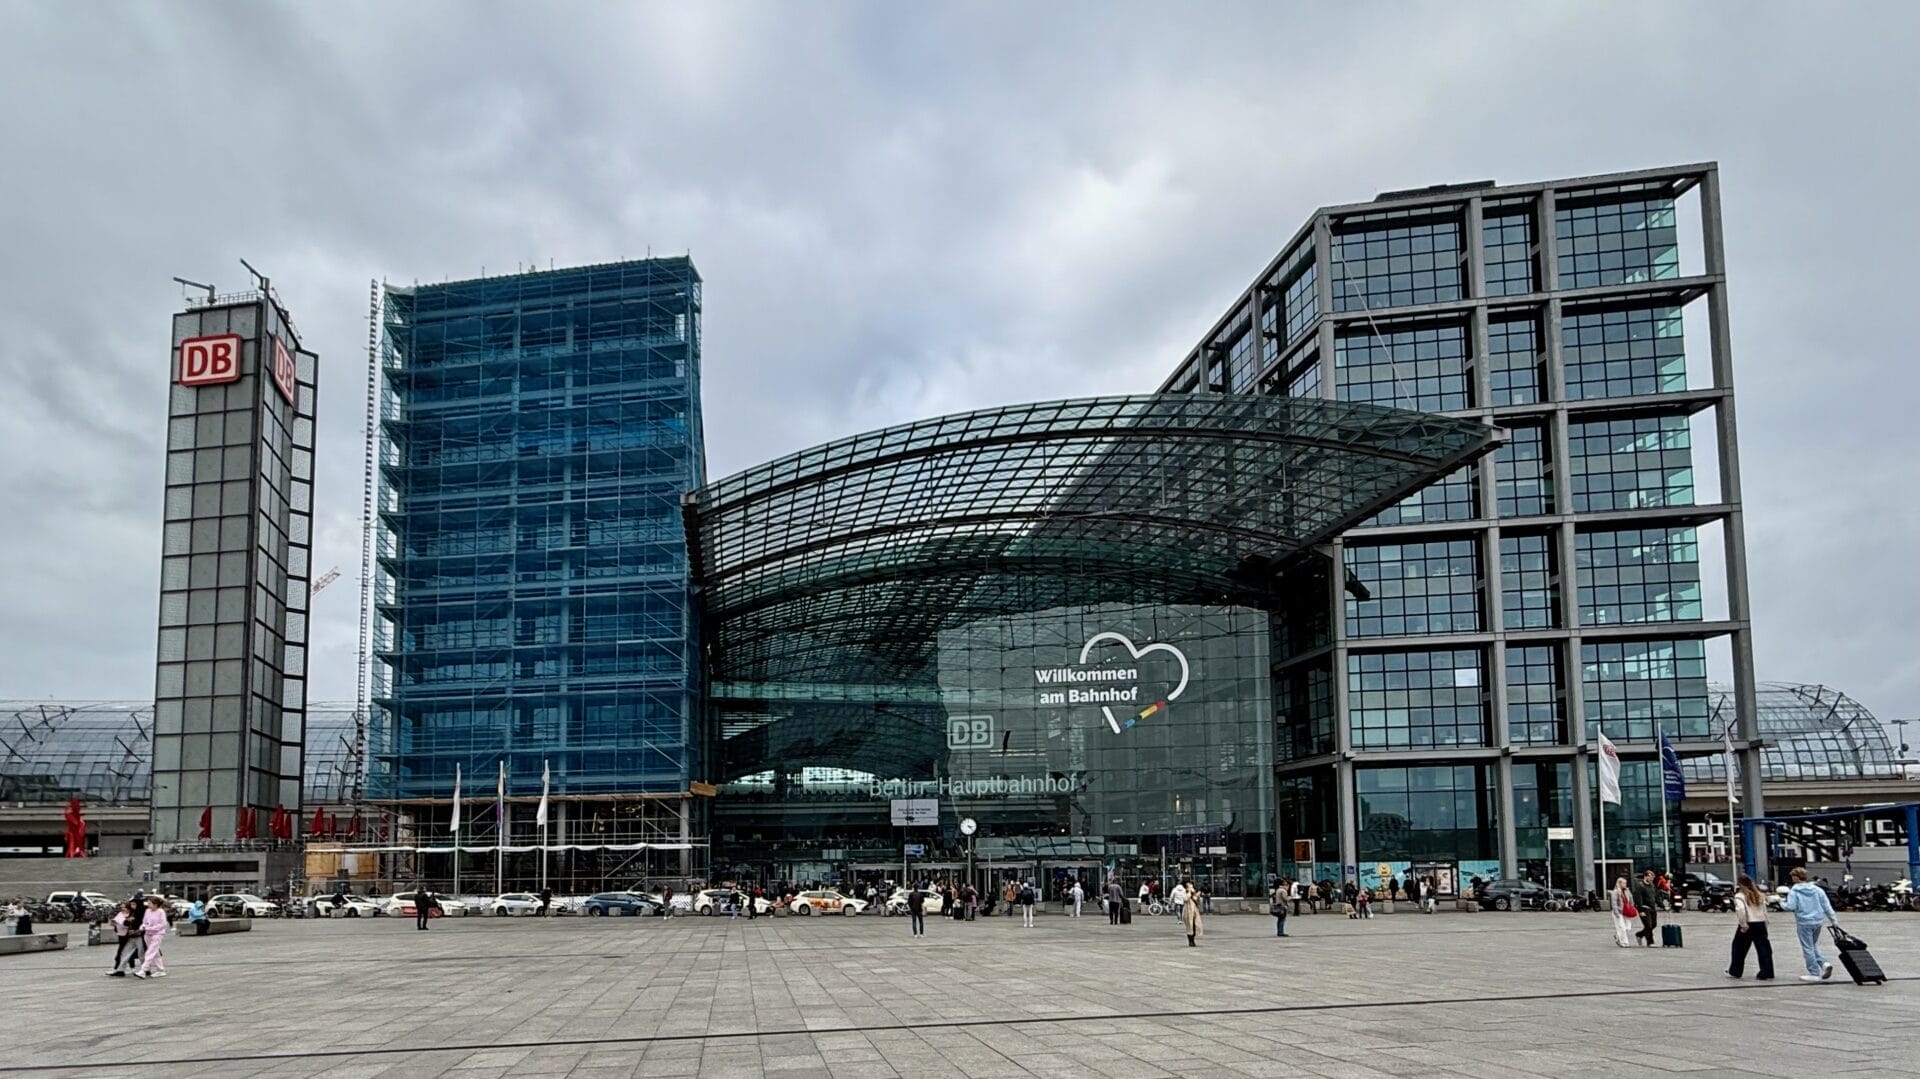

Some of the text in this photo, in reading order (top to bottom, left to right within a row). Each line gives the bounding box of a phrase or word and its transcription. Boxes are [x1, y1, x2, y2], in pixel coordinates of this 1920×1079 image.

[187, 343, 231, 377] DB
[277, 349, 293, 394] DB
[1035, 668, 1138, 683] Willkommen
[1040, 687, 1138, 704] am Bahnhof
[952, 720, 989, 744] DB
[870, 773, 1077, 798] Berlin Hauptbahnhof
